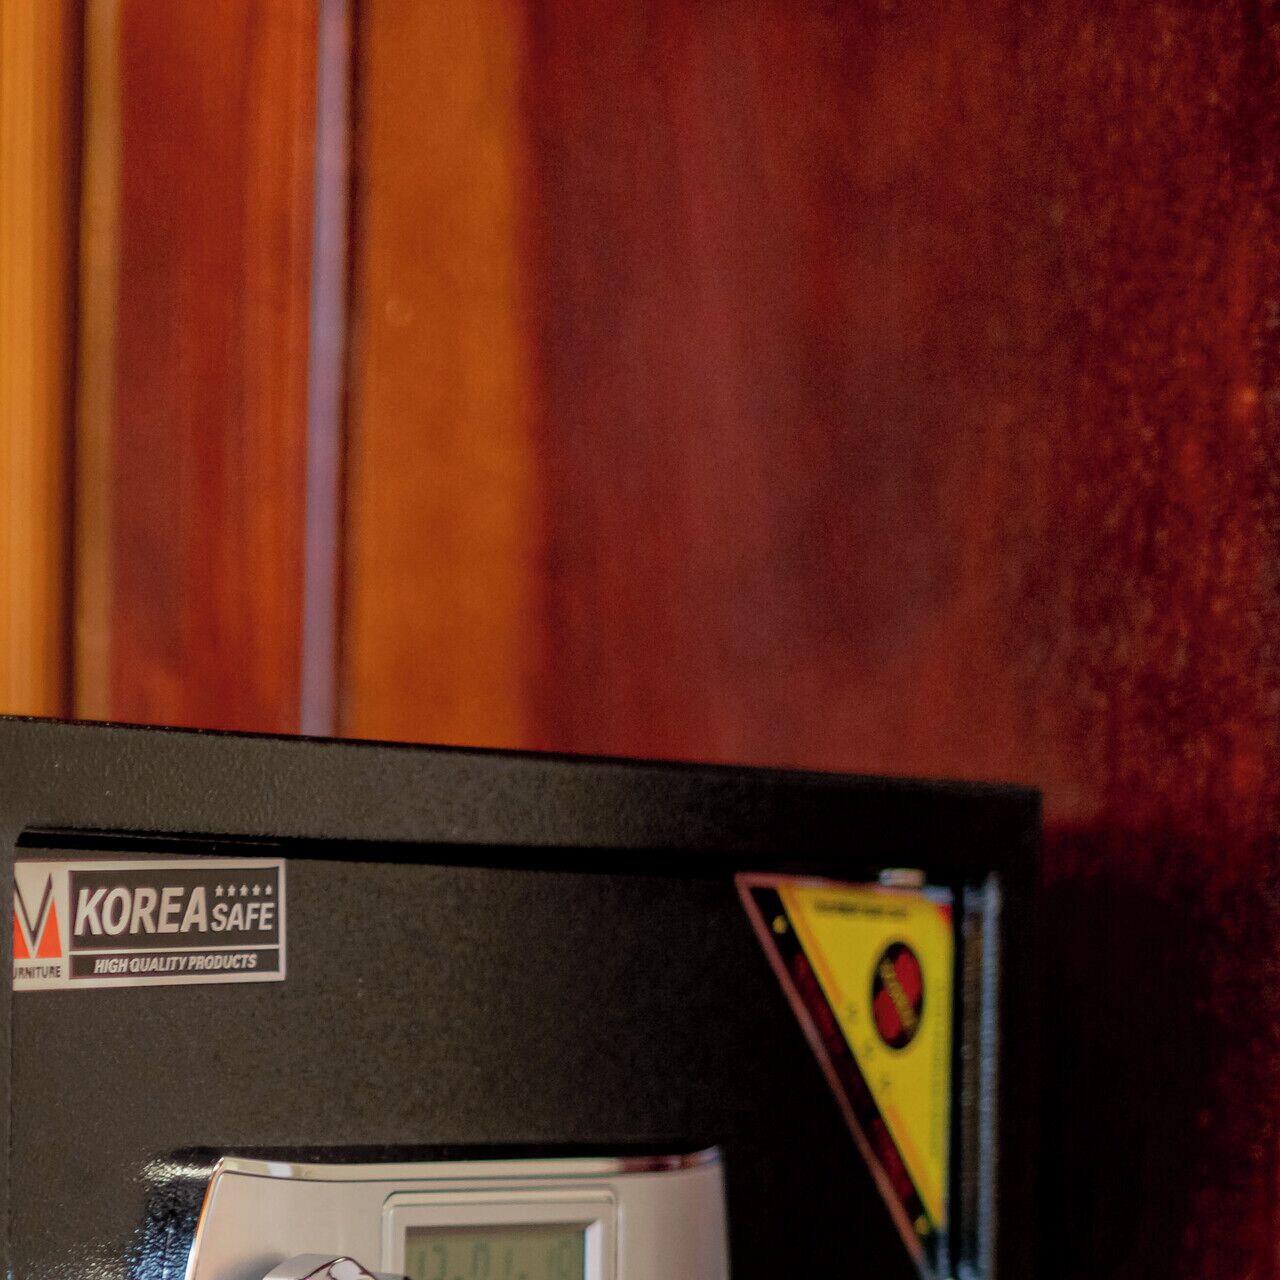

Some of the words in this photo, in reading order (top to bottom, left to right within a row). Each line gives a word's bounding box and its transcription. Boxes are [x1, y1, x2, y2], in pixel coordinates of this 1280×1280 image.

[74, 886, 209, 936] KOREA
[210, 902, 275, 933] SAFE
[93, 958, 128, 974] HIGH
[129, 956, 188, 972] QUALITY
[187, 953, 258, 971] PRODUCTS
